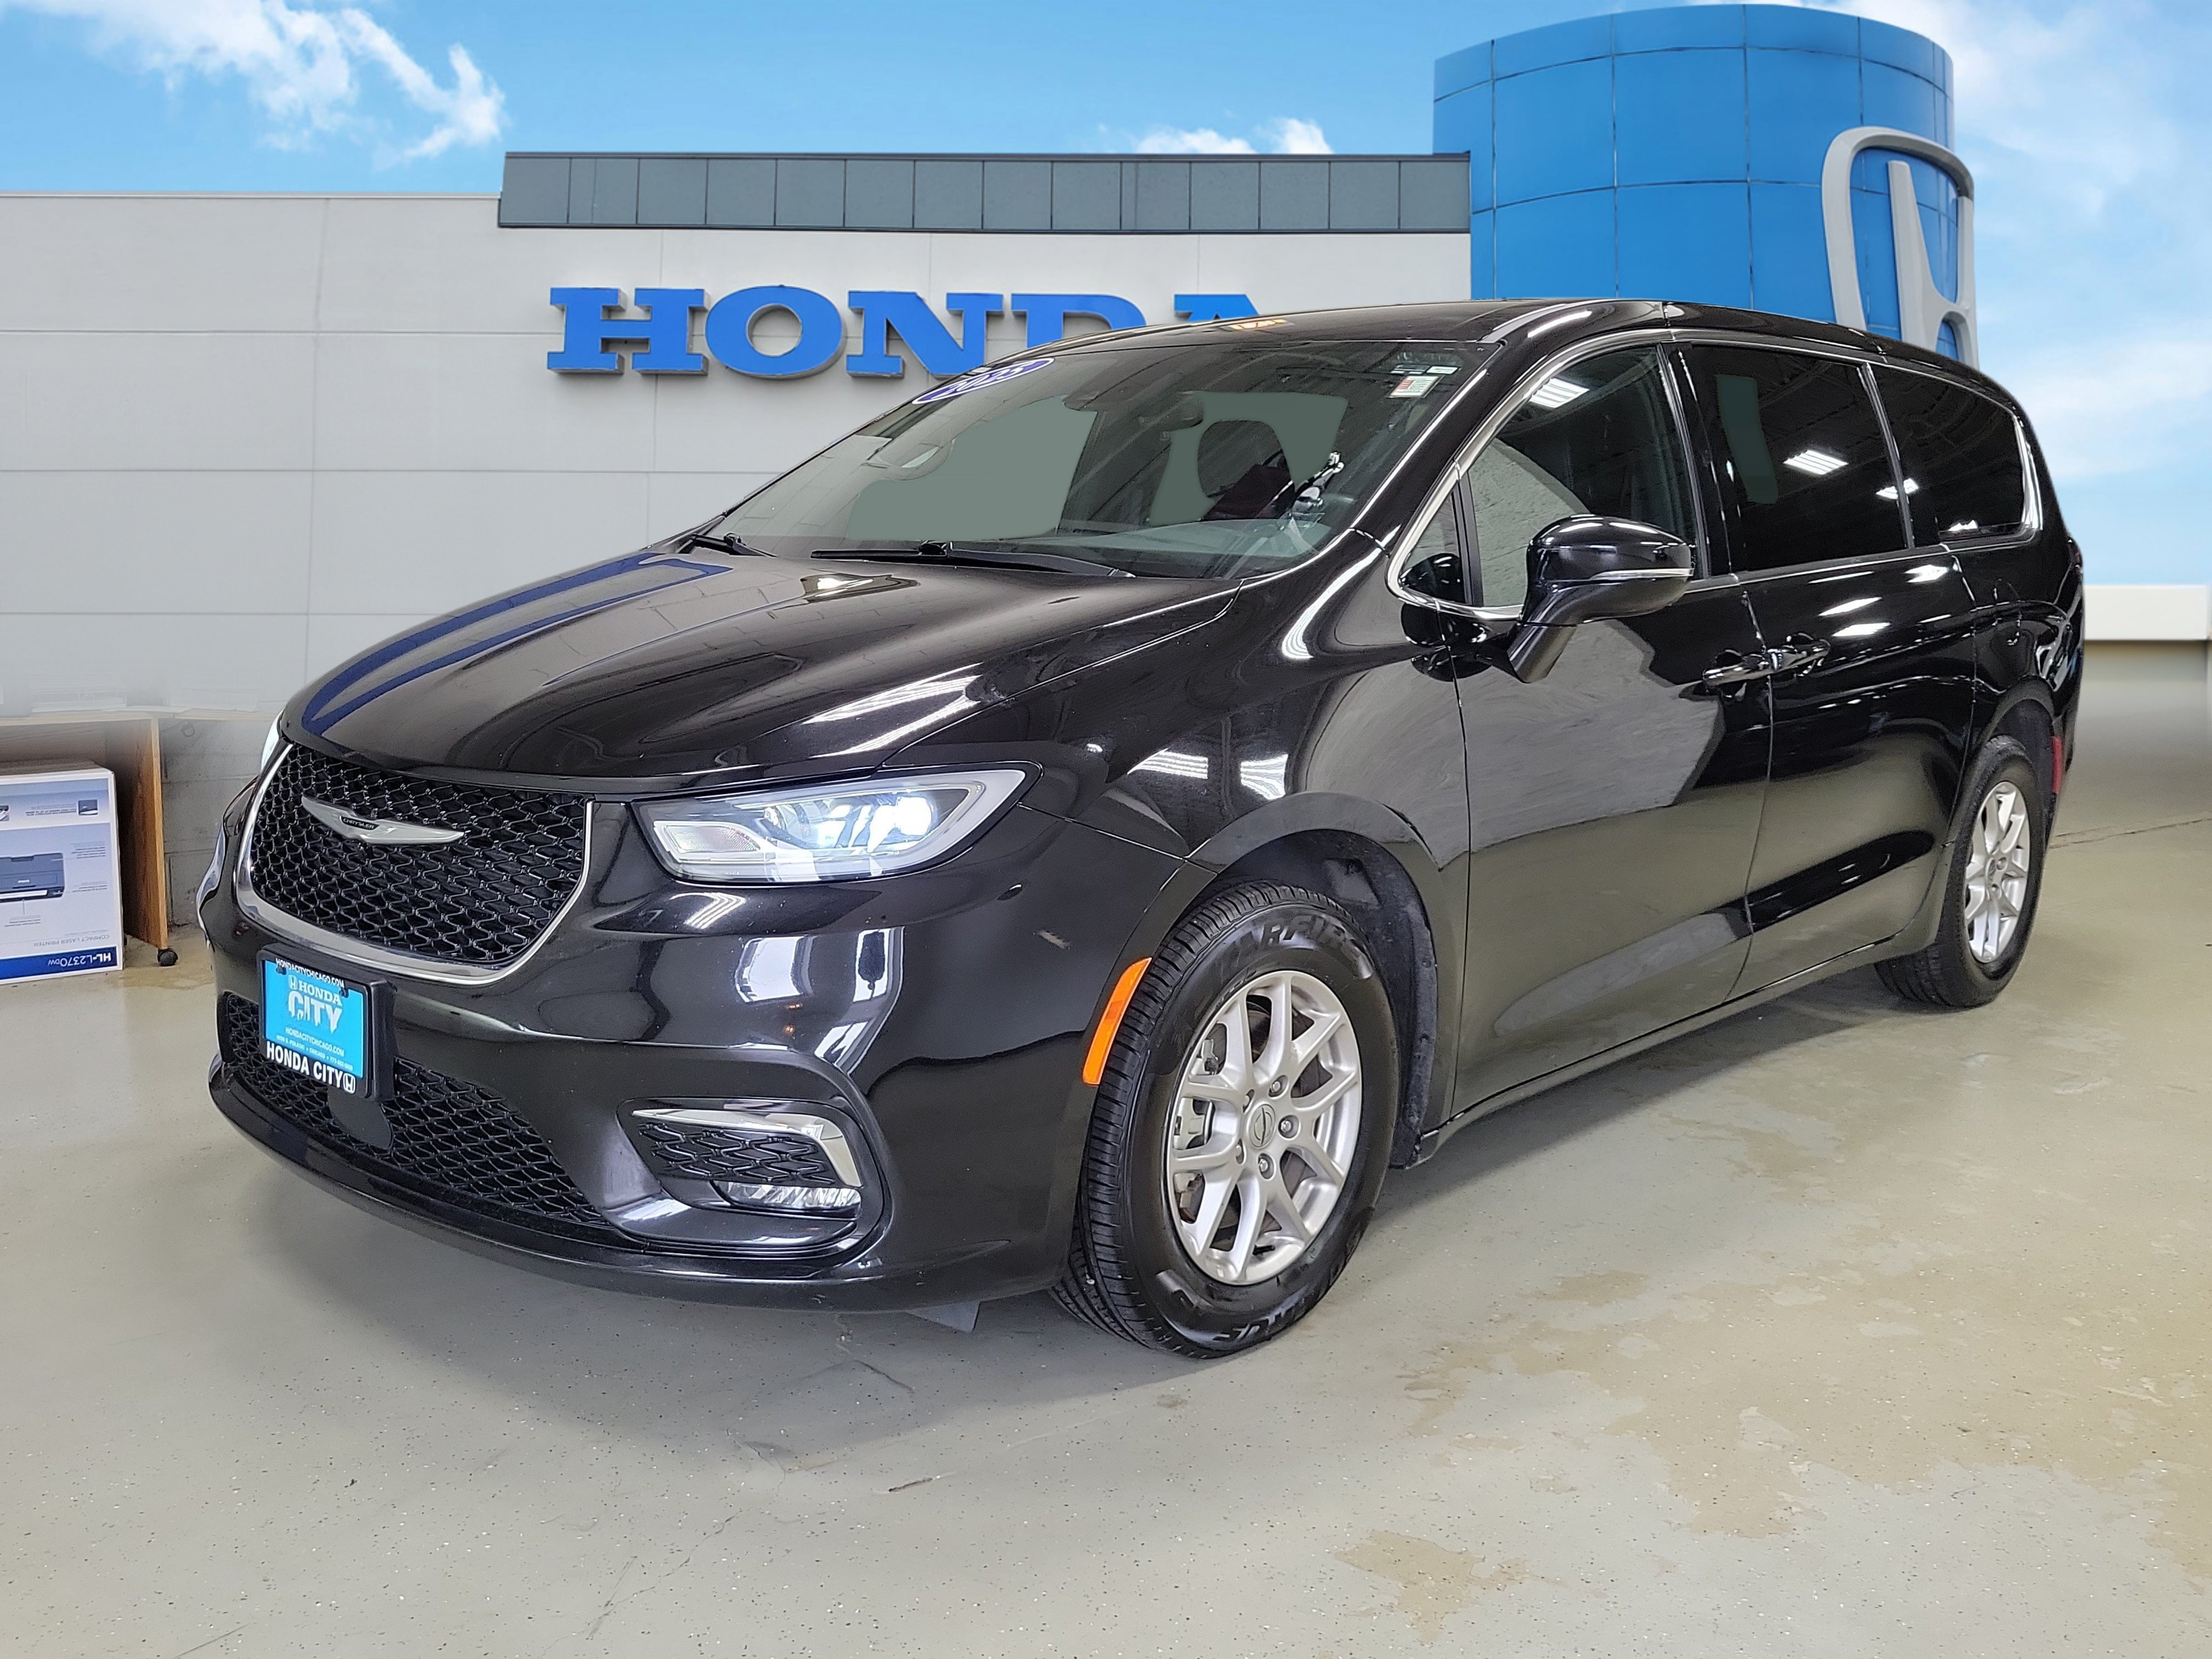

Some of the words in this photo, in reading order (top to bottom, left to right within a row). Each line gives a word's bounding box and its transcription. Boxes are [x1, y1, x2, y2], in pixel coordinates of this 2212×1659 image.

[342, 818, 375, 829] CHRYSLER
[33, 939, 59, 948] PRINTER
[81, 934, 110, 943] COMPACT
[47, 952, 112, 967] HL-L2370DW
[275, 957, 345, 988] HONDACITYCHICAGO.COM
[298, 980, 343, 1007] HONDA
[287, 990, 343, 1034] CITY
[285, 1026, 345, 1057] HONDACITYCHICAGO.COM
[267, 1040, 310, 1076] HONDA
[313, 1060, 343, 1088] CITY
